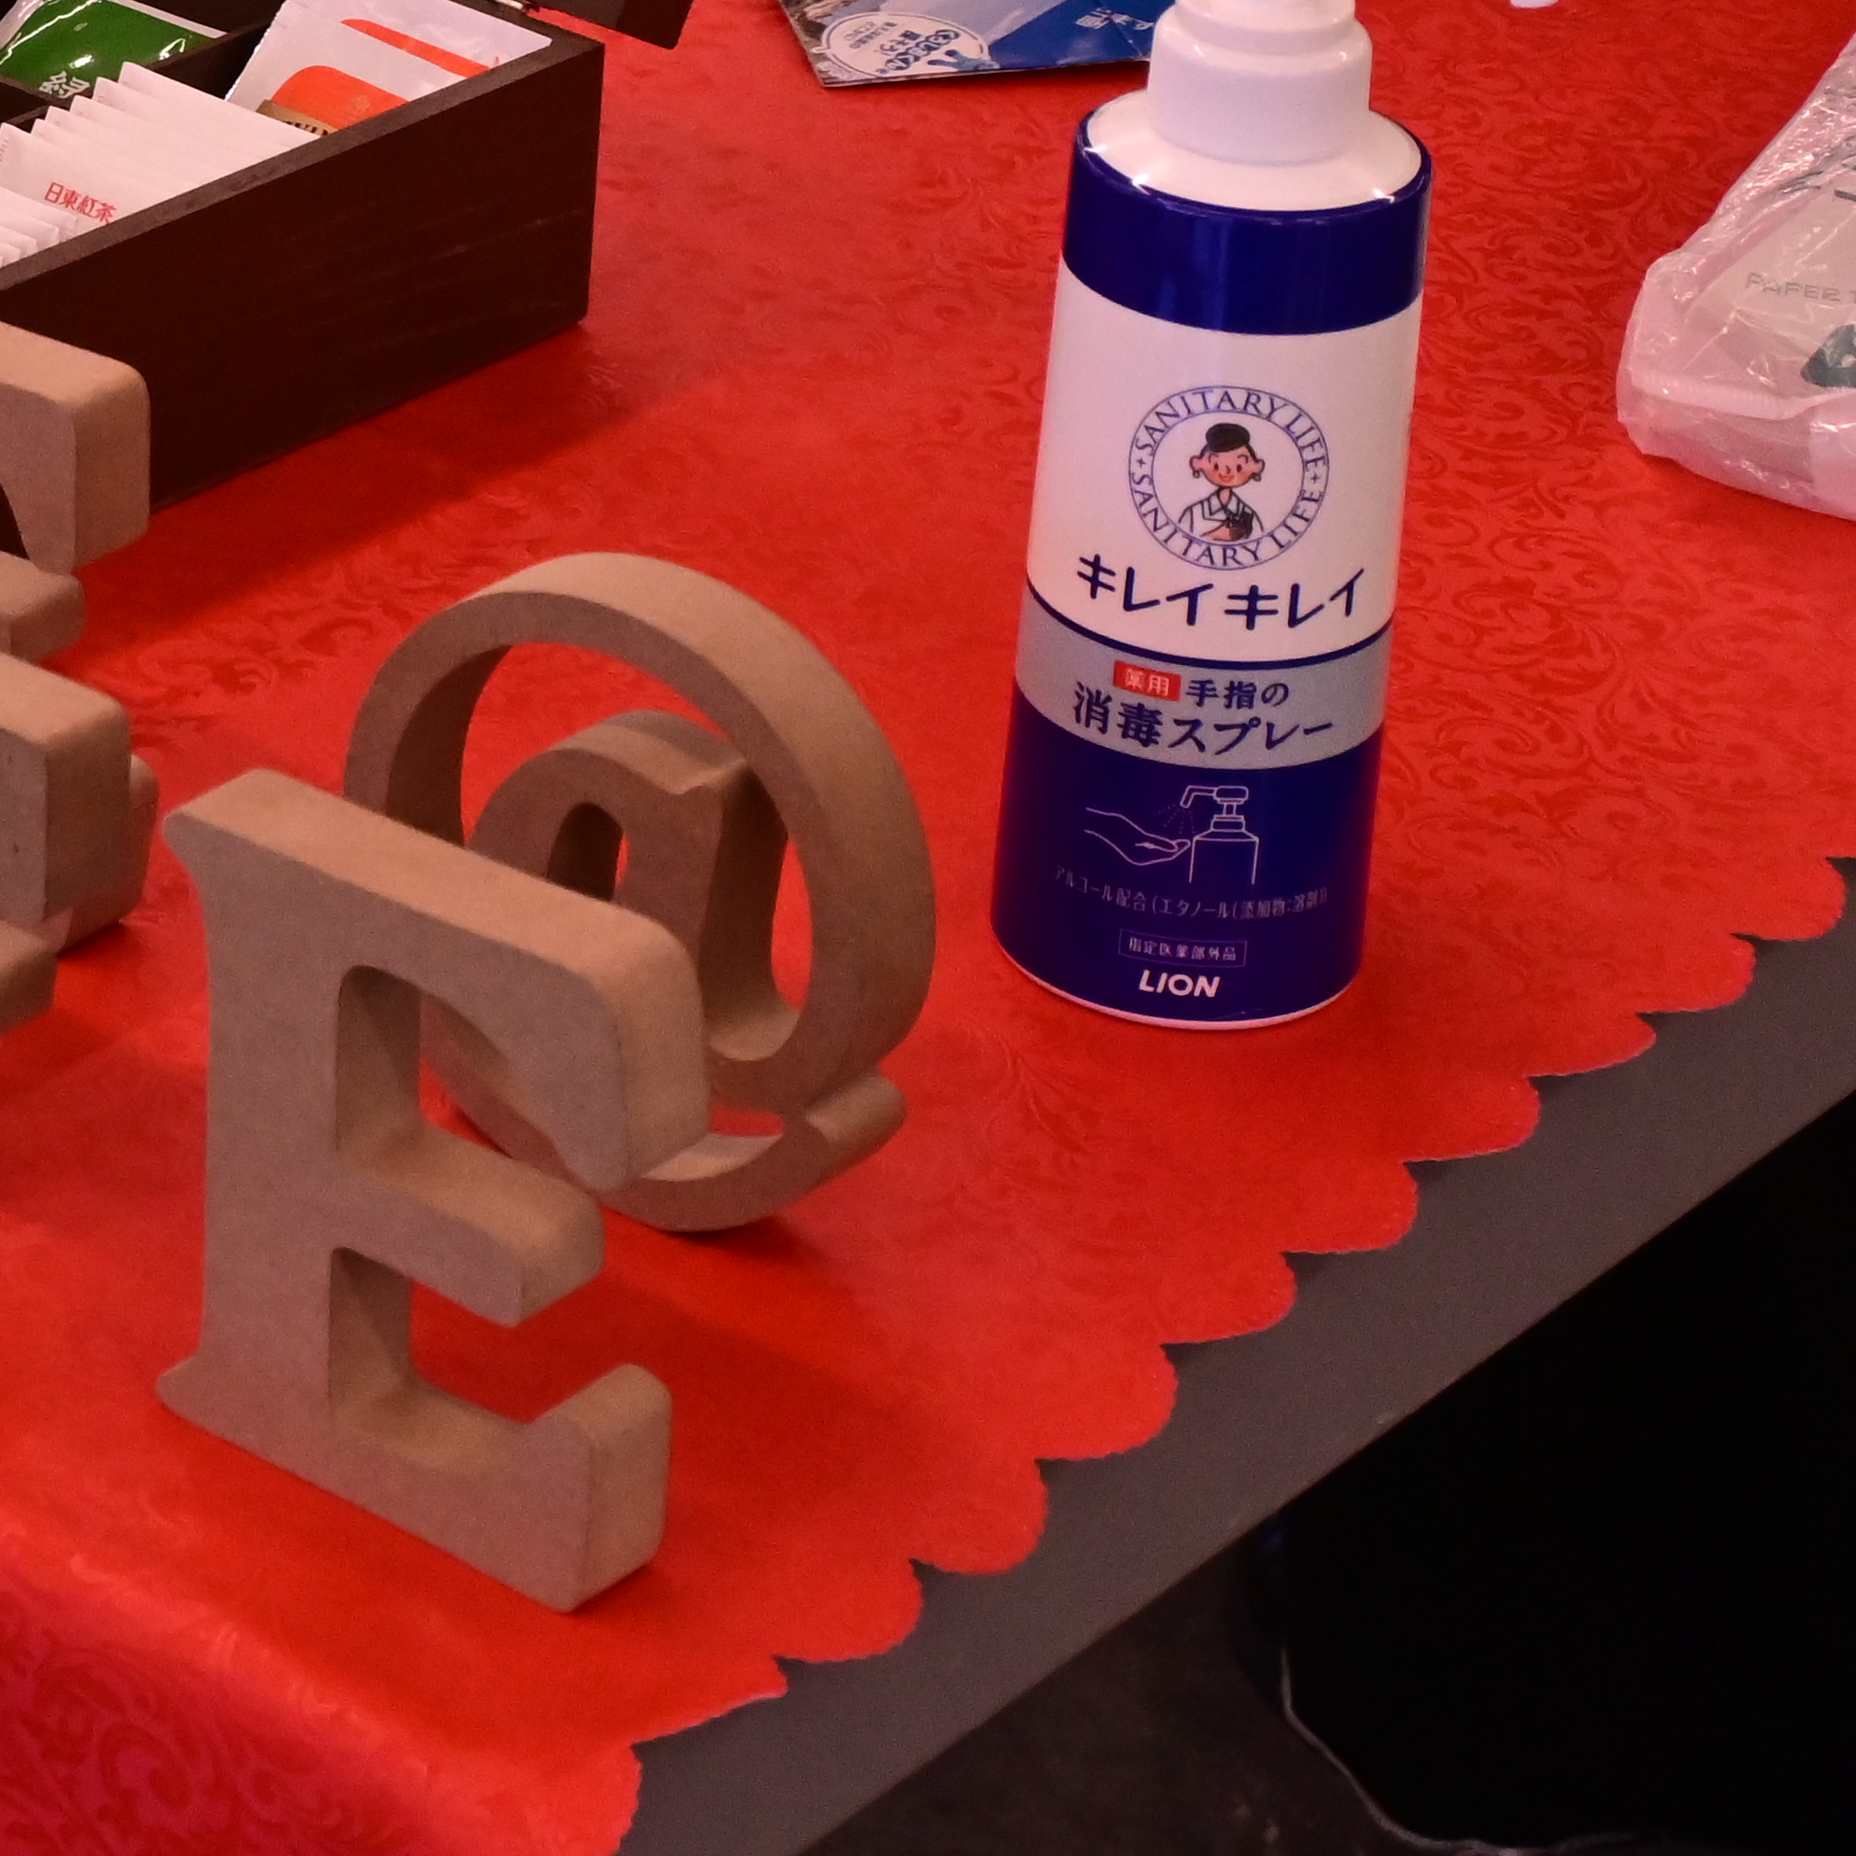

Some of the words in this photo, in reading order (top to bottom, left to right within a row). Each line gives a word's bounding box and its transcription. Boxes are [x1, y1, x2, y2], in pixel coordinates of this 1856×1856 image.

[44, 181, 117, 225] 日東紅茶
[1134, 389, 1288, 457] SANITARY
[1284, 412, 1326, 473] LIFE
[1131, 472, 1265, 567] SANITARY
[1268, 488, 1324, 550] LIFE
[1077, 554, 1364, 630] キレイキレイ
[1122, 667, 1171, 696] 薬用
[1186, 679, 1289, 709] 手指の
[1072, 681, 1333, 755] 消毒スプレー
[1128, 937, 1237, 962] 指定医薬部外品
[1139, 969, 1221, 998] LION
